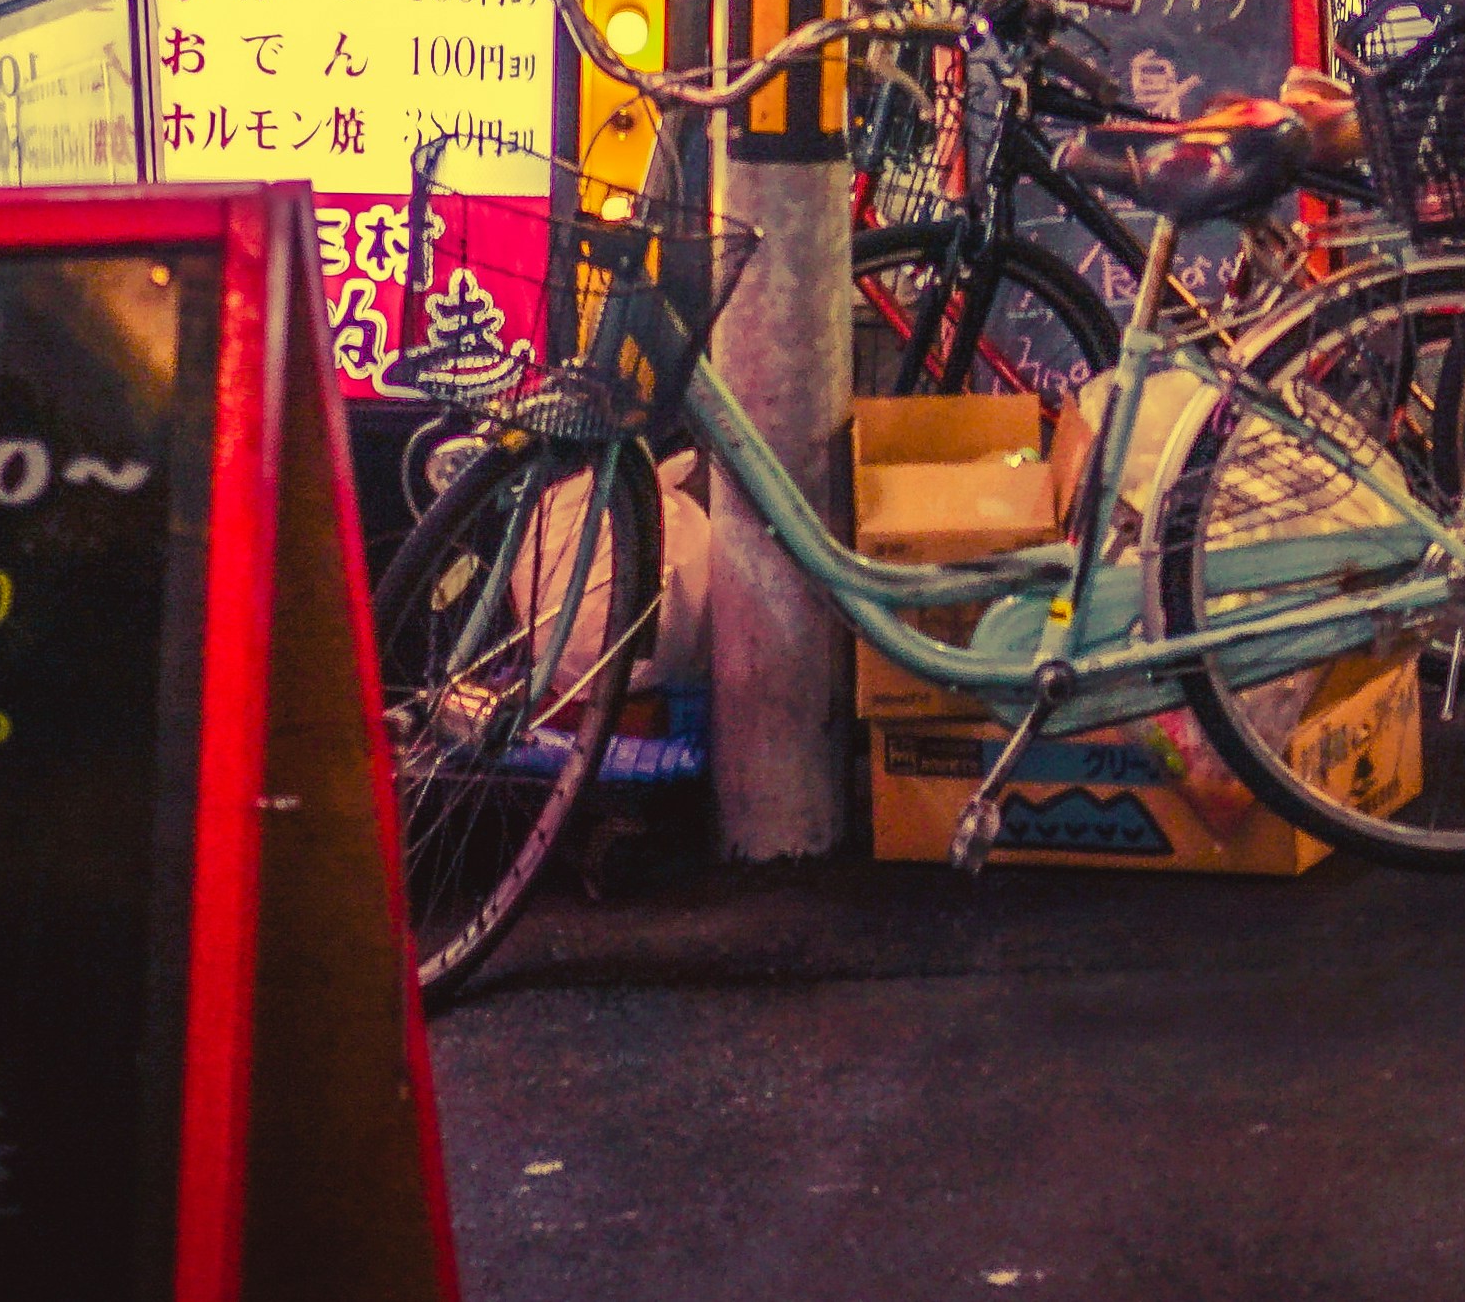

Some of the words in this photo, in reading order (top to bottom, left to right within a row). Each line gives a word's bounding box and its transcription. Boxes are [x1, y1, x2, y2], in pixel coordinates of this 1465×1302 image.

[161, 25, 369, 79] おでん
[162, 103, 367, 156] ホルモン焼
